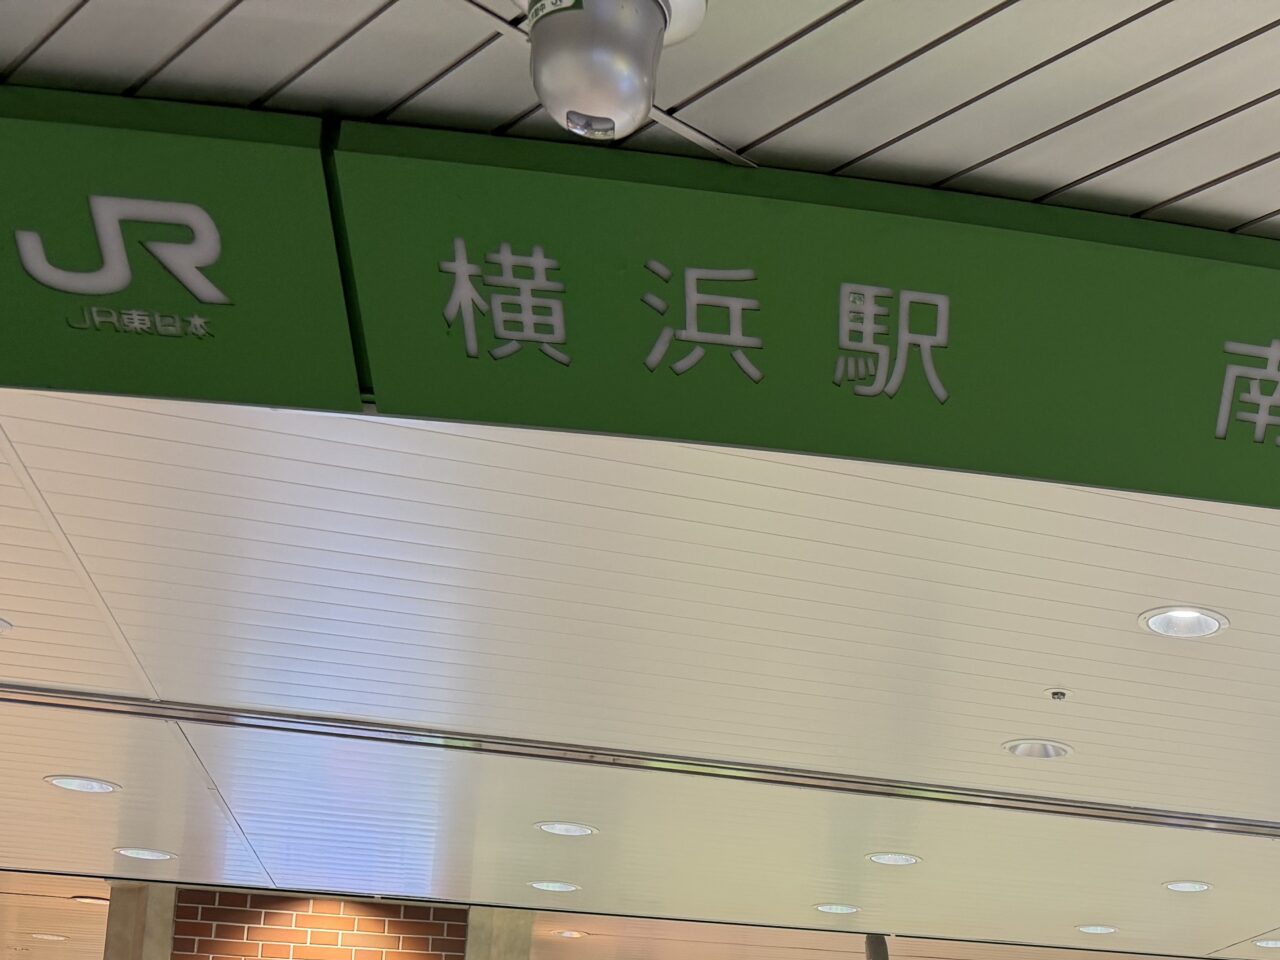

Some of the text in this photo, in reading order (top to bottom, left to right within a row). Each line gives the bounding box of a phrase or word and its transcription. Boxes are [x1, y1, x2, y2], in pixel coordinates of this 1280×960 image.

[15, 195, 234, 306] JR
[66, 305, 215, 340] JR東日本
[438, 236, 951, 404] 横浜駅
